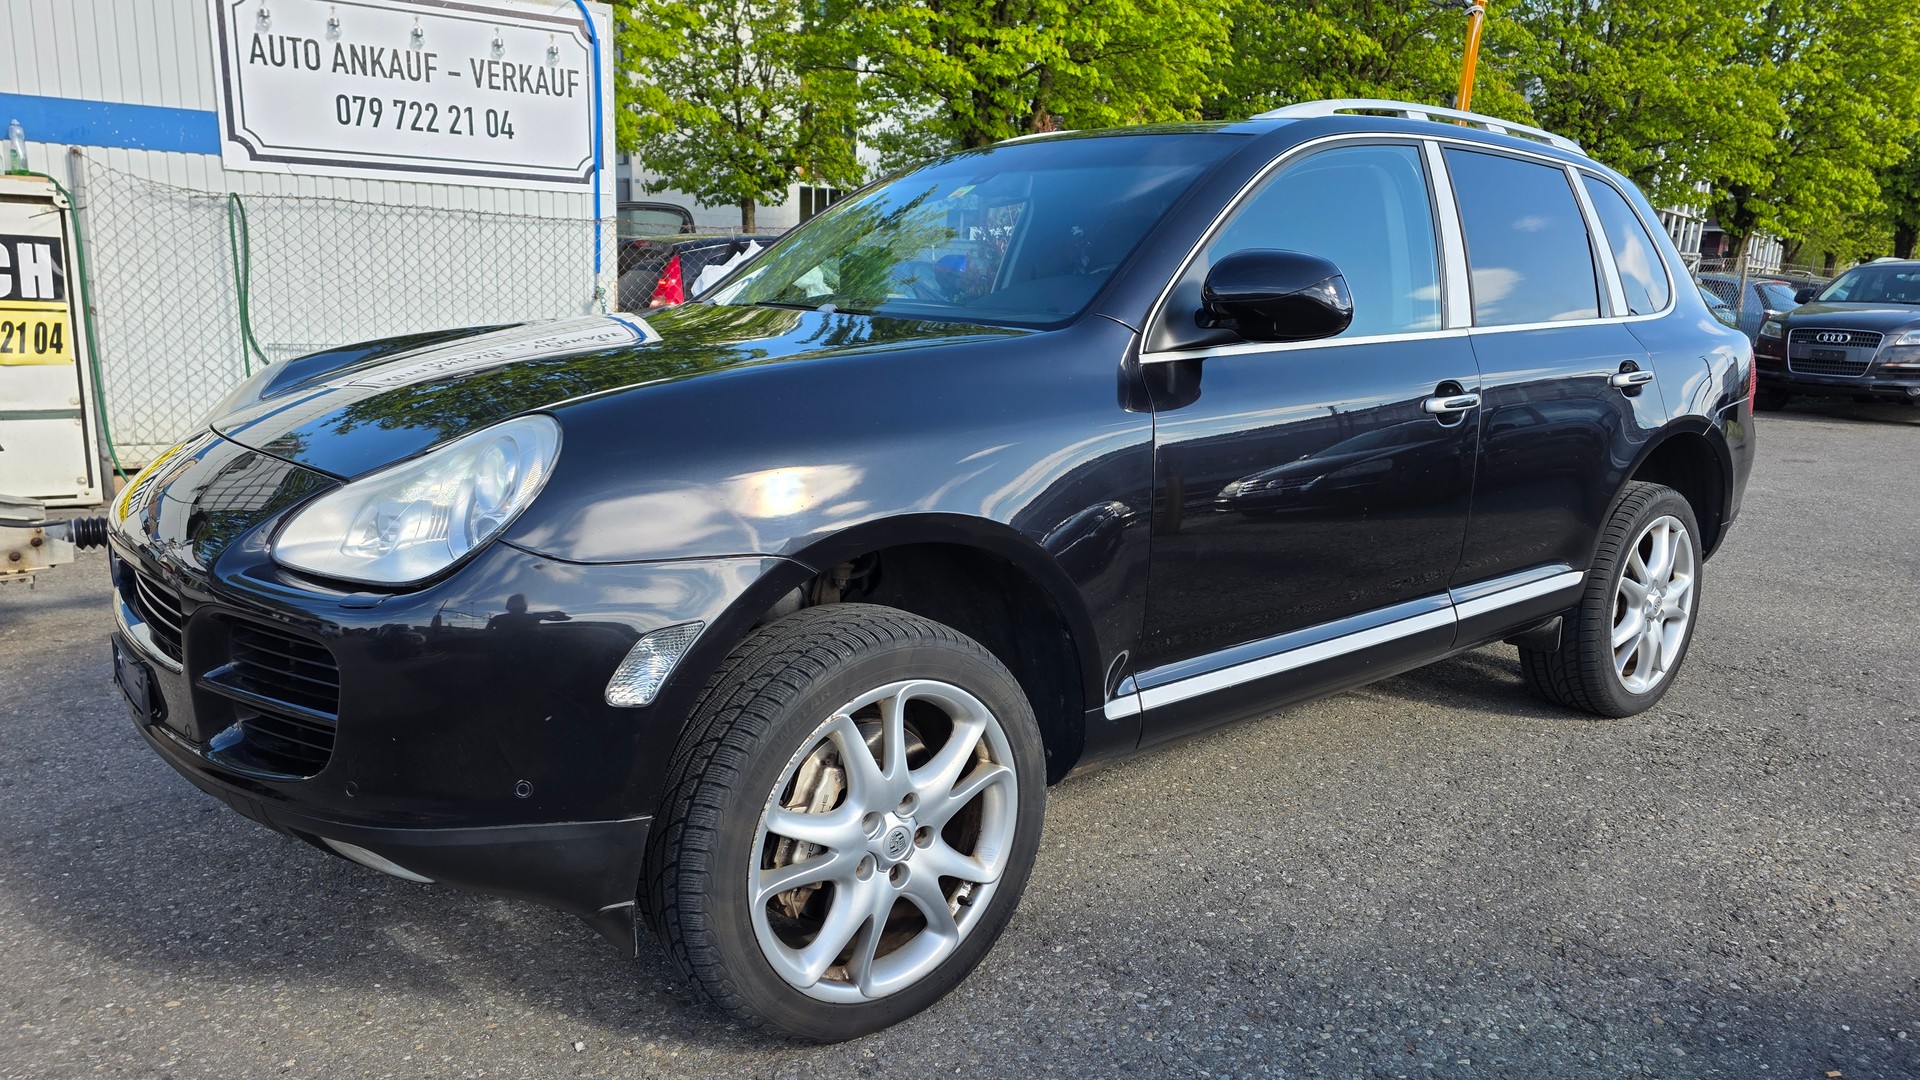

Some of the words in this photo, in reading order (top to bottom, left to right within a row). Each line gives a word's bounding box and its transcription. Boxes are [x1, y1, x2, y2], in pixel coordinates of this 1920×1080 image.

[249, 32, 321, 71] AUTO
[331, 42, 437, 83] ANKAUF
[469, 57, 579, 98] VERKAUF
[335, 94, 383, 128] 079
[393, 99, 440, 133] 722
[448, 105, 474, 136] 21
[485, 108, 514, 140] 04
[0, 320, 26, 354] 21
[34, 321, 63, 355] 04
